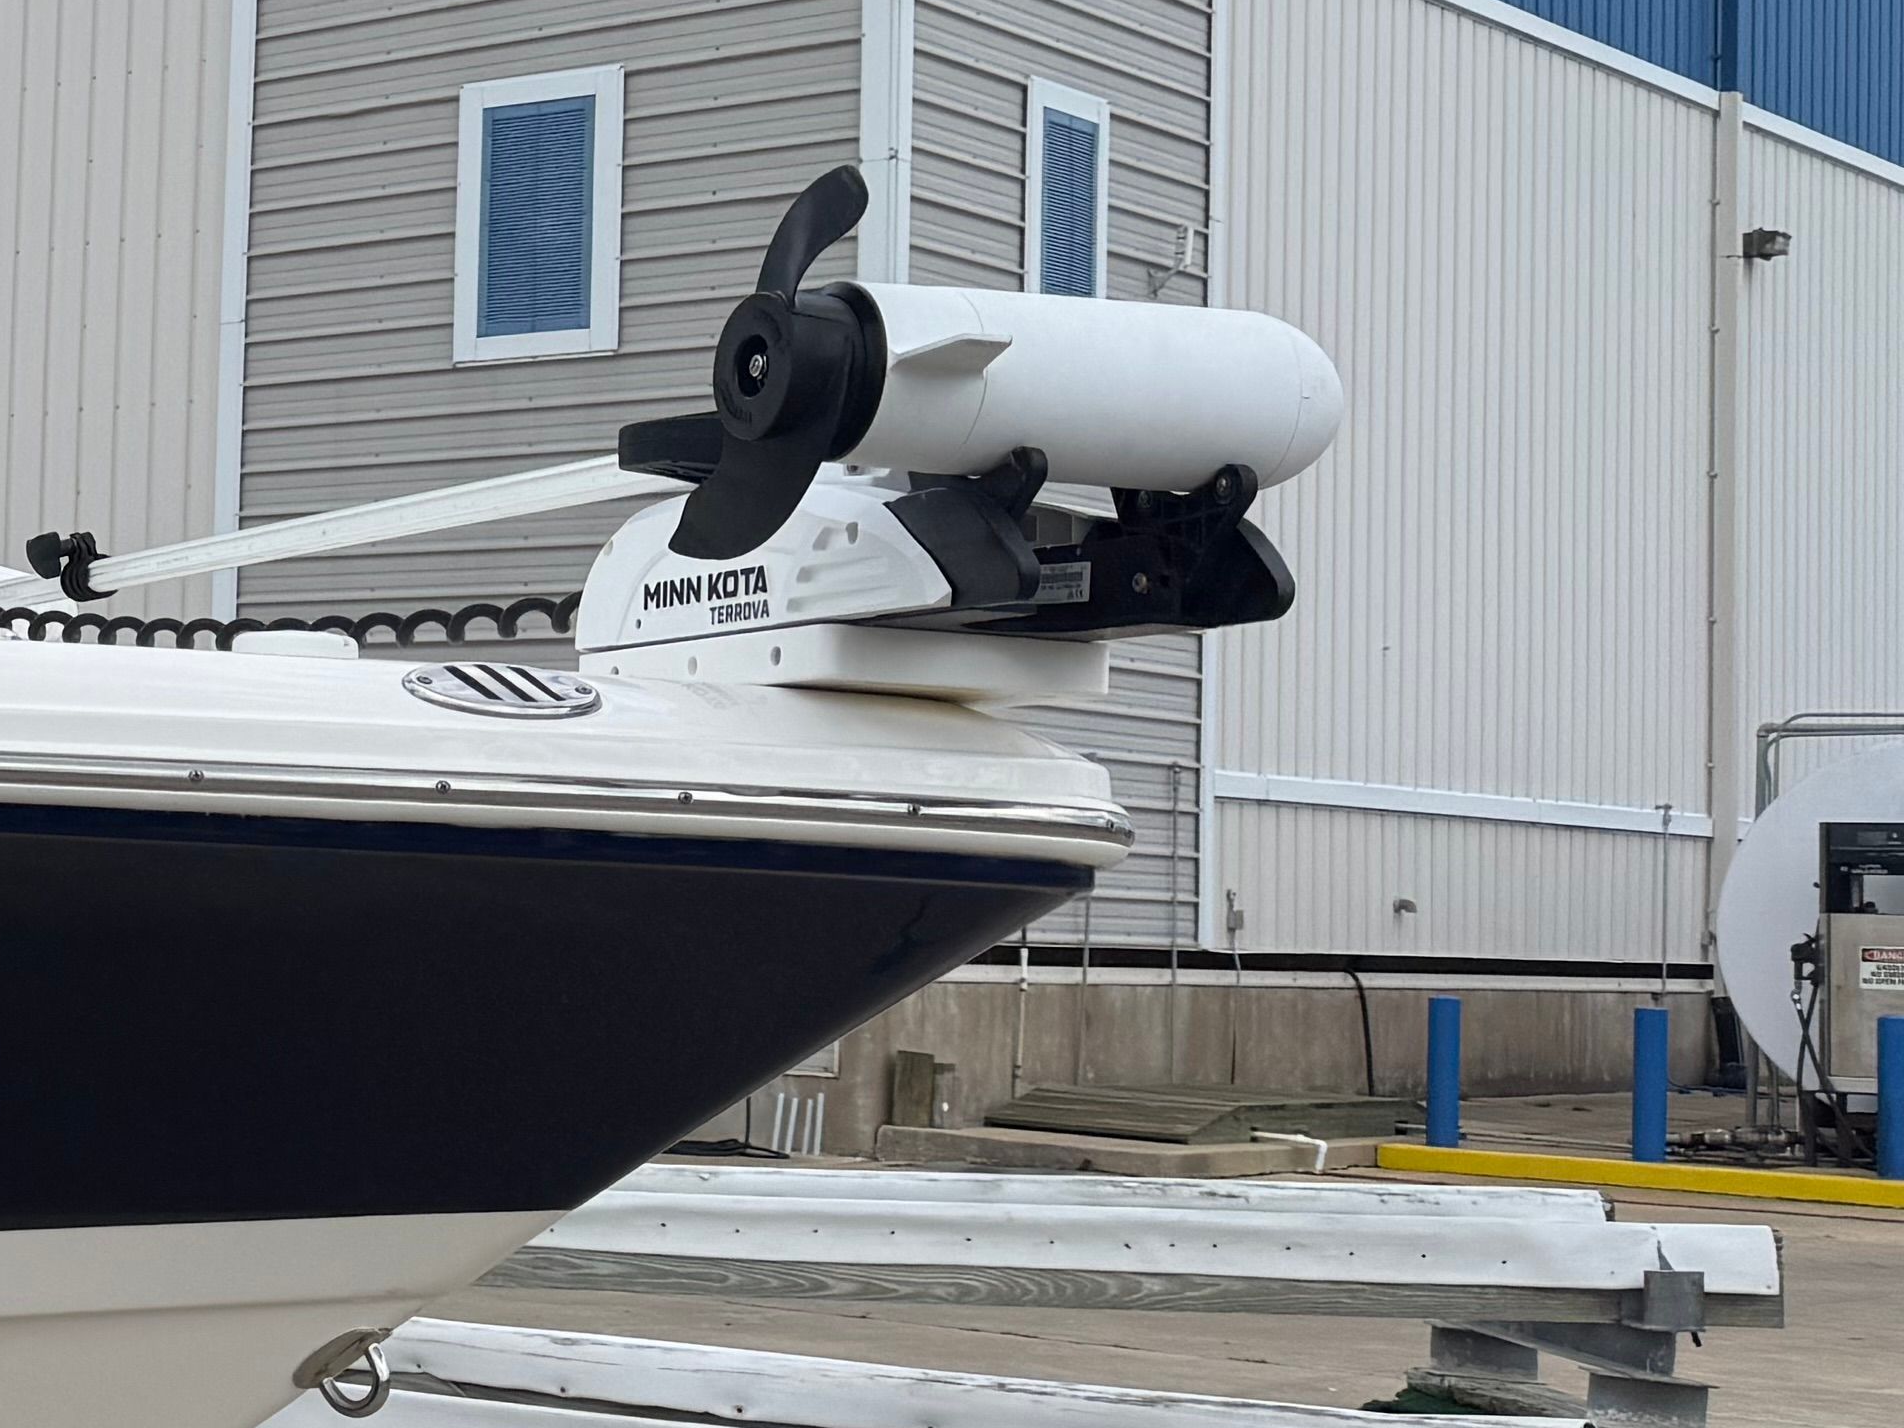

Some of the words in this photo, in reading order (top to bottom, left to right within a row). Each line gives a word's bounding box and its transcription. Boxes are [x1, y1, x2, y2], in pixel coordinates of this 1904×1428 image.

[643, 575, 702, 611] MINN
[707, 565, 768, 601] KOTA
[709, 599, 770, 625] TERROVA
